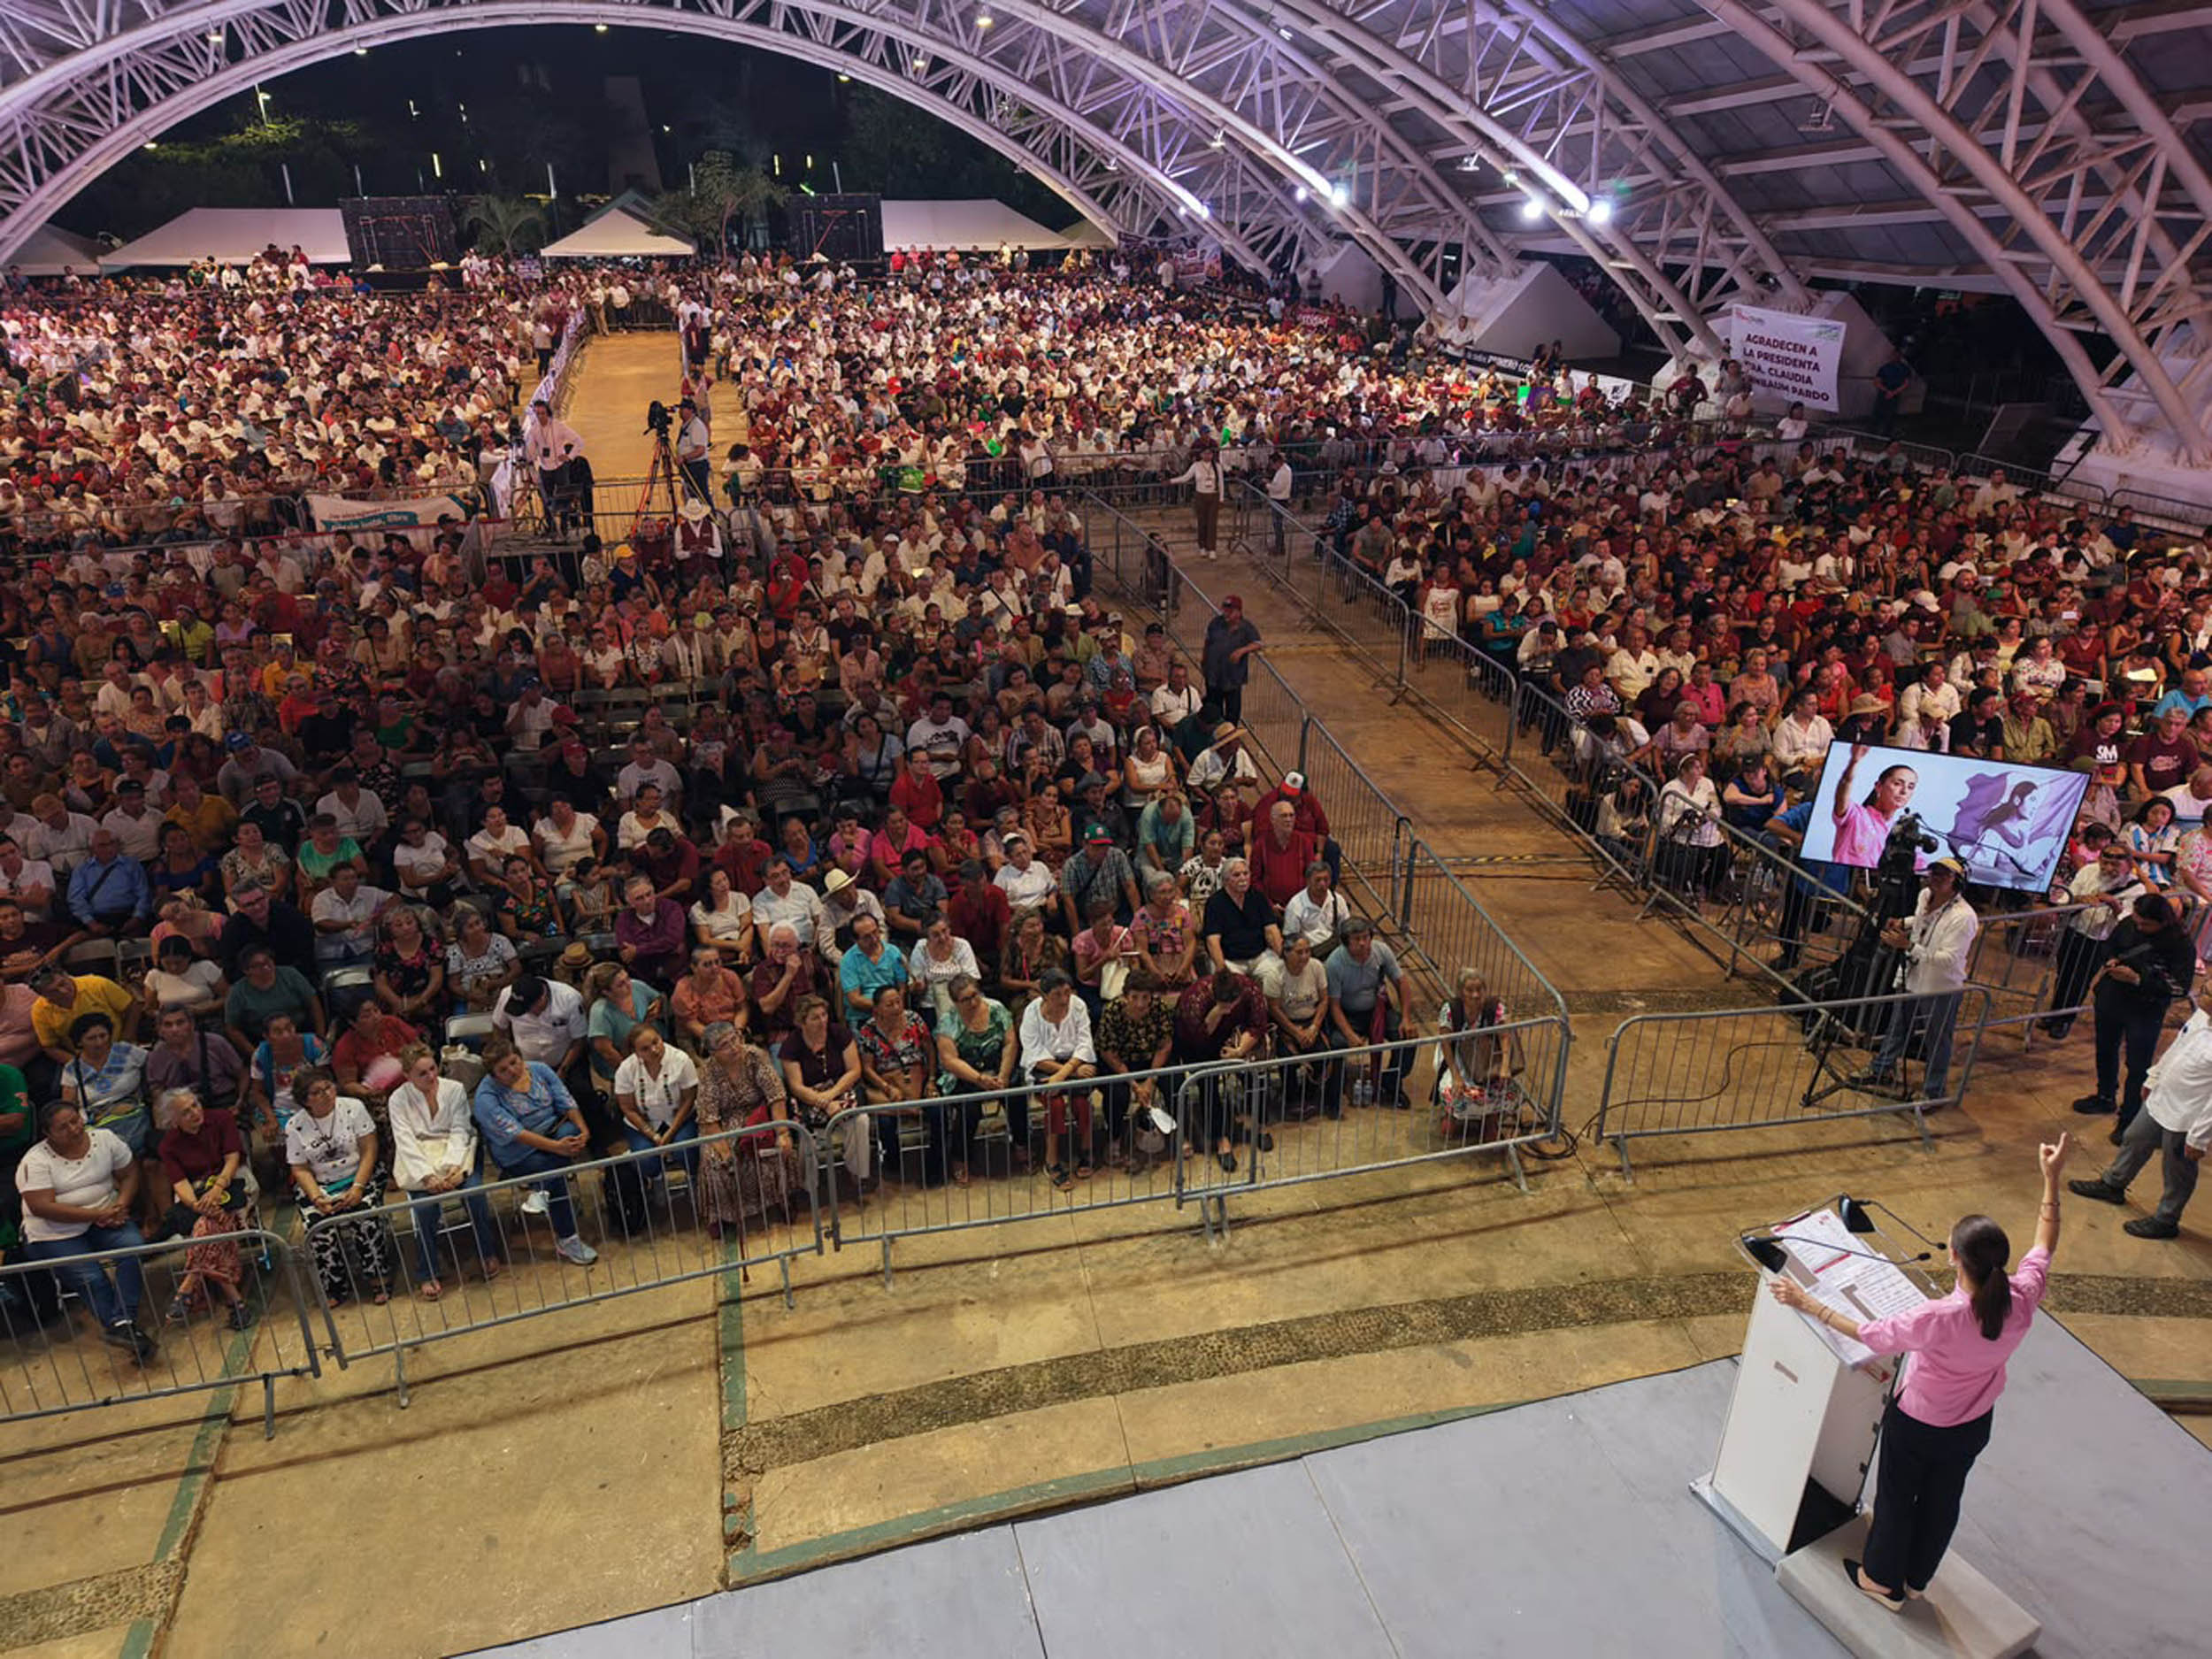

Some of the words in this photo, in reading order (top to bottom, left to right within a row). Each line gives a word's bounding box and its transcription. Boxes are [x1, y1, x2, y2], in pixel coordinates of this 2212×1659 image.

[1746, 333, 1806, 355] AGRADECEN
[1809, 346, 1817, 357] A
[1743, 347, 1755, 358] LA
[1756, 350, 1820, 372] PRESIDENTA
[1768, 367, 1813, 386] CLAUDIA
[1792, 387, 1830, 402] PARDO
